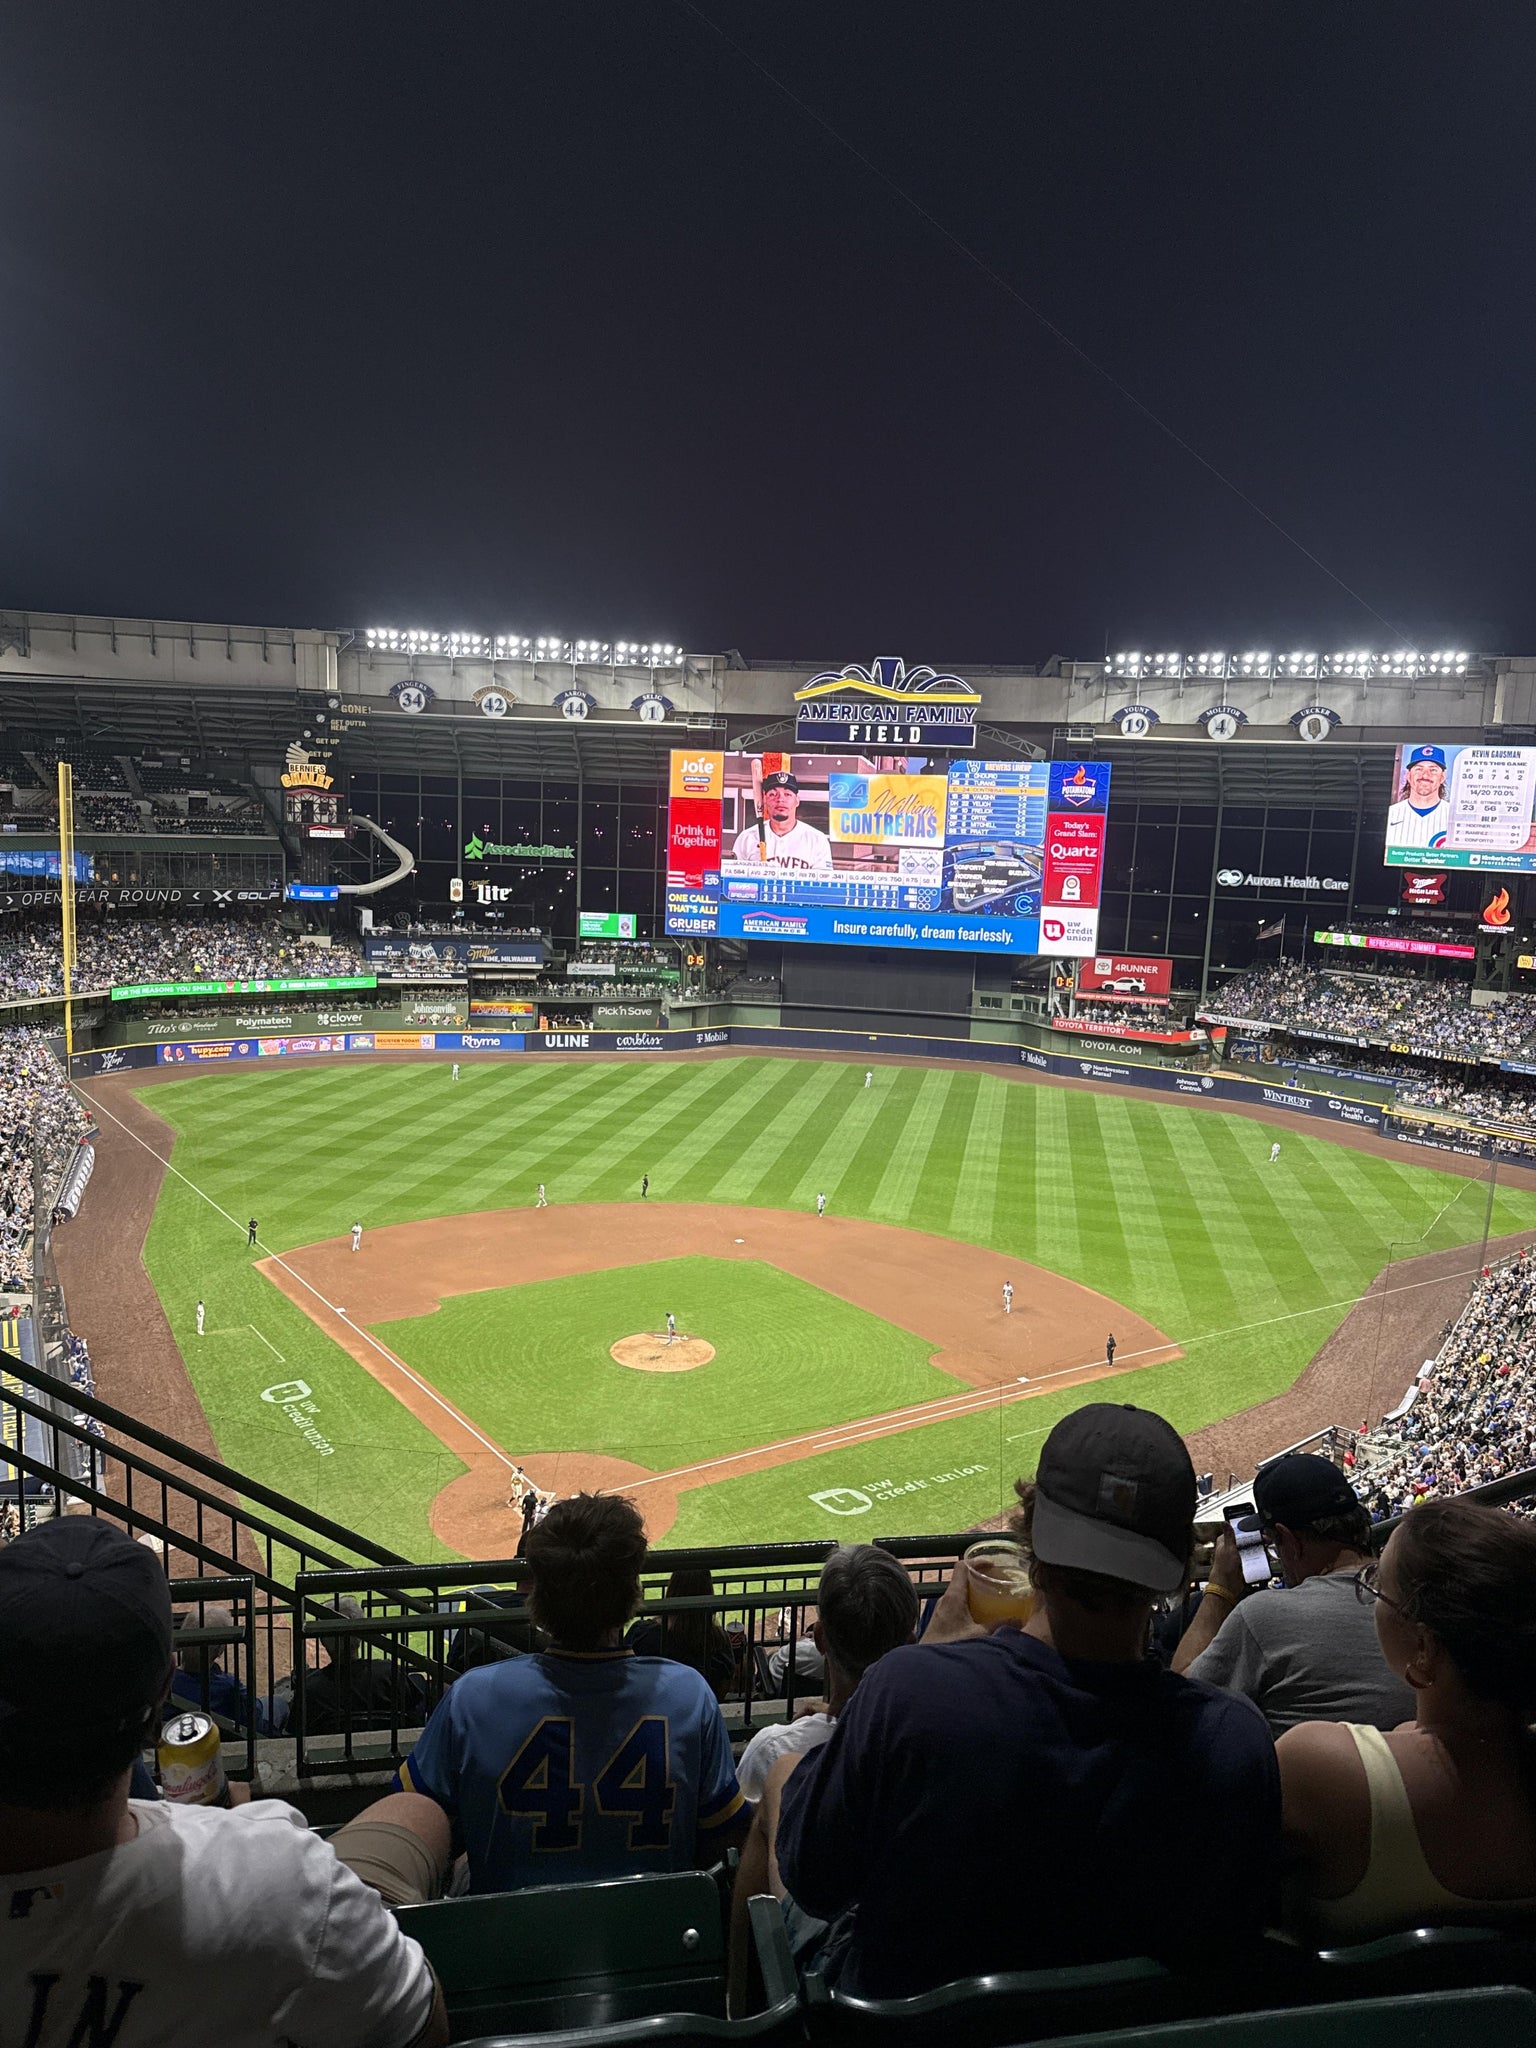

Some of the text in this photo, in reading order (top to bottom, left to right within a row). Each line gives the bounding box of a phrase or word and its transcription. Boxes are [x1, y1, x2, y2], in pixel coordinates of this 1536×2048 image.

[397, 681, 428, 692] FINGERS
[564, 691, 587, 699] AARON
[642, 694, 664, 702] SELIG
[402, 693, 424, 711] 34
[484, 699, 504, 713] 42
[341, 705, 372, 714] GONE!
[565, 702, 586, 716] 44
[649, 707, 656, 720] 1
[798, 704, 977, 724] AMERICAN FAMILY
[1123, 706, 1149, 714] YOUNT
[1206, 706, 1241, 717] MOLITOR
[1300, 707, 1330, 717] UECKER
[1125, 718, 1145, 733] 19
[1215, 719, 1226, 734] 4
[849, 725, 921, 744] FIELD
[1472, 750, 1521, 759] KEVIN GAUSMAN
[289, 764, 326, 774] BERNIE'S
[680, 757, 714, 774] Joie
[281, 773, 334, 790] CHALET
[831, 781, 868, 803] 24
[1470, 789, 1491, 797] 14/20
[873, 789, 937, 816] William
[675, 824, 716, 836] Drink in
[840, 812, 937, 838] CONTRERAS
[1063, 822, 1089, 831] Today's
[1077, 830, 1098, 838] Slam:
[672, 834, 719, 849] Together
[482, 842, 575, 859] AssociatedBank
[1050, 843, 1098, 858] Quartz
[1244, 874, 1349, 890] Aurora Health Care
[21, 890, 182, 905] OPEN YEAR ROUND
[237, 892, 281, 900] GOLF
[476, 884, 513, 905] Lite
[668, 894, 688, 902] ONE
[668, 905, 698, 913] THAT'S
[669, 918, 716, 930] GRUBER
[743, 919, 806, 929] AMERICAN FAMILY
[747, 926, 803, 934] INSURANCE
[833, 920, 1014, 945] Insure carefully, dream fearlessly.
[1066, 927, 1093, 935] credit
[1369, 938, 1437, 954] REFRESHINGLY SUMMER
[467, 947, 499, 961] Miller
[1114, 963, 1158, 975] 4RUNNER
[1056, 976, 1074, 988] 0:15
[117, 989, 129, 997] FOR
[130, 988, 141, 996] THE
[142, 986, 174, 995] REASONS
[412, 1003, 456, 1014] Johnsonville
[598, 1007, 618, 1016] Pick
[628, 1007, 653, 1016] Save
[236, 1015, 292, 1026] Polymatech
[329, 1013, 363, 1023] clover
[147, 1023, 177, 1035] Tito's
[1054, 1020, 1126, 1035] TOYOTA TERRITORY
[462, 1035, 501, 1049] Rhyme
[545, 1034, 590, 1047] ULINE
[616, 1033, 664, 1046] carbliss
[704, 1031, 728, 1042] Mobile
[190, 1046, 233, 1056] hupy.com
[1079, 1039, 1142, 1055] TOYOTA.COM
[1390, 1043, 1441, 1059] 620 WTMJ
[1027, 1052, 1047, 1067] Mobile
[1092, 1064, 1130, 1075] Northwestern
[1092, 1070, 1112, 1078] Mutual
[1175, 1077, 1199, 1086] Johnson
[1179, 1084, 1202, 1093] Controls
[1263, 1088, 1313, 1107] WINTRUST
[1342, 1103, 1364, 1114] Aurora
[1341, 1110, 1380, 1124] Health Care
[1406, 1137, 1422, 1145] Aurora
[1423, 1139, 1438, 1148] Health
[1452, 1146, 1480, 1156] BULLPEN
[300, 1400, 321, 1413] uw
[282, 1404, 336, 1457] credit union
[862, 1478, 894, 1492] uw
[876, 1463, 989, 1501] credit union
[497, 1715, 677, 1852] 44
